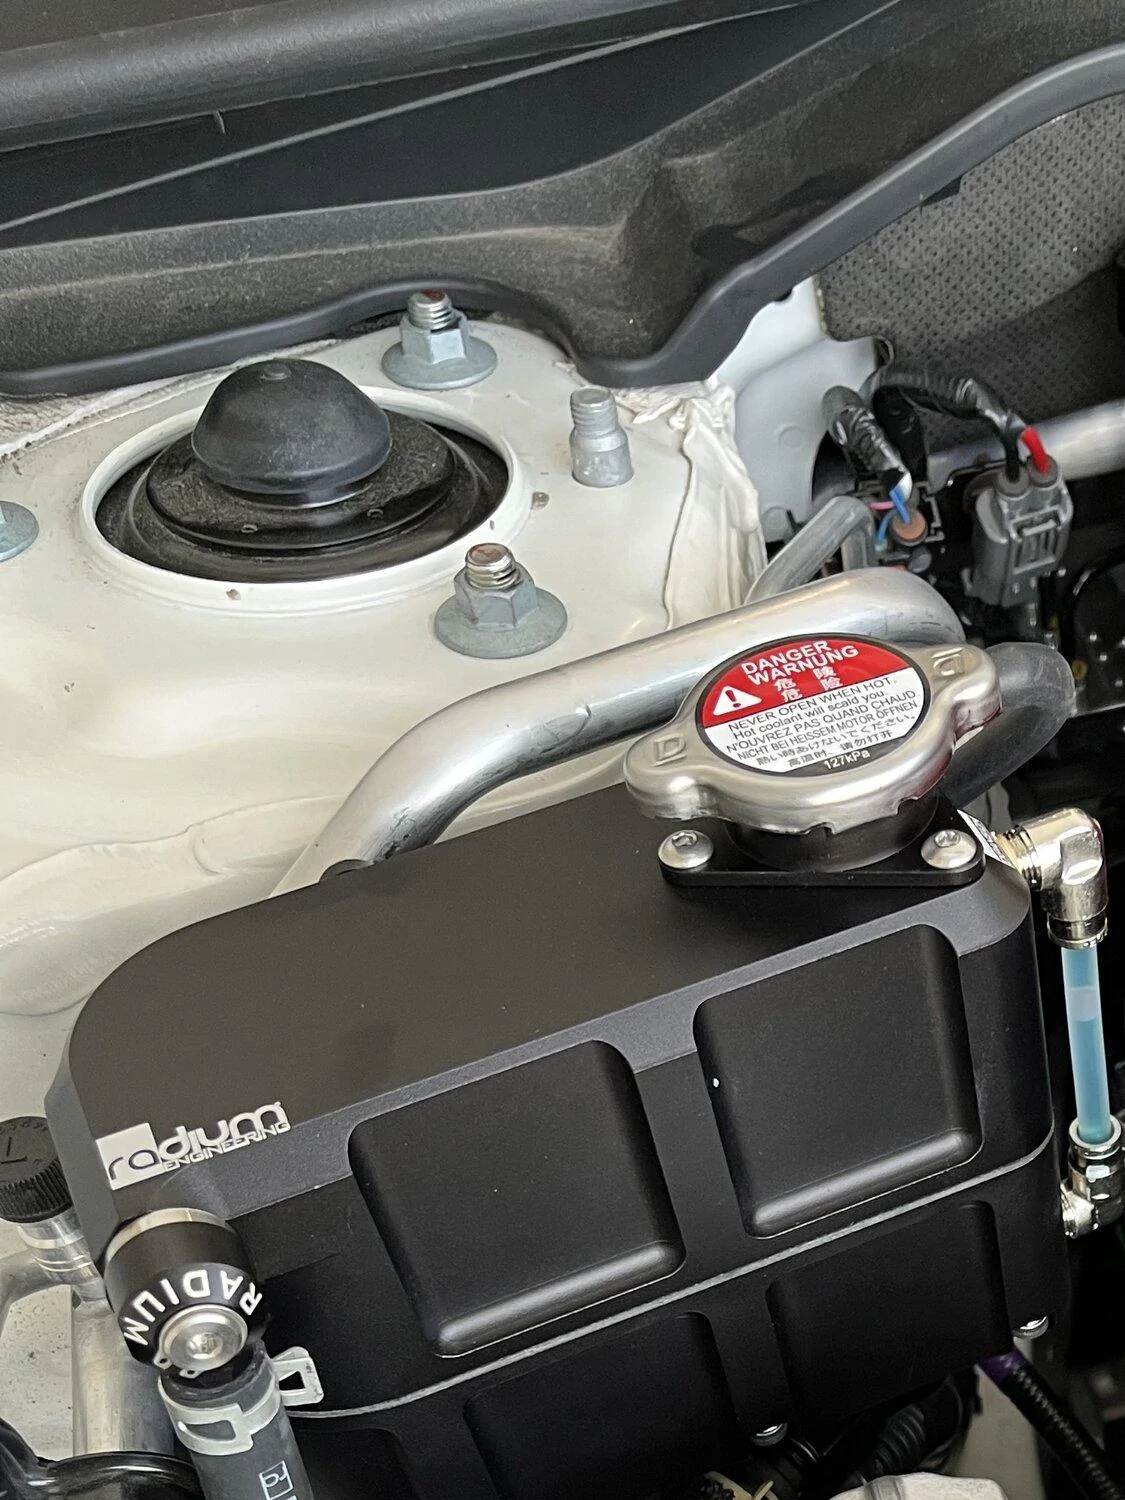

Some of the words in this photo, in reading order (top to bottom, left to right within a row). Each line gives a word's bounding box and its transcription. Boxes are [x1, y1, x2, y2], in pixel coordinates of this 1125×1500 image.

[741, 640, 832, 675] DANGER
[747, 645, 859, 686] WARNUNG
[726, 727, 793, 754] N'OUVREZ
[793, 718, 821, 733] PAS
[823, 704, 869, 724] QUAND
[728, 711, 777, 733] NEVER
[778, 698, 818, 716] OPEN
[819, 686, 861, 703] WHEN
[733, 728, 756, 741] Hot
[758, 713, 803, 733] coolant
[804, 705, 826, 718] will
[827, 696, 860, 712] scald
[737, 744, 770, 761] NICHT
[771, 739, 790, 752] BEI
[789, 723, 837, 746] HEISSEM
[836, 713, 876, 732] MOTOR
[823, 749, 871, 770] 127kPa
[97, 1102, 288, 1188] radium
[164, 1121, 291, 1172] ENGINEERING
[123, 1269, 262, 1346] RADIUM
